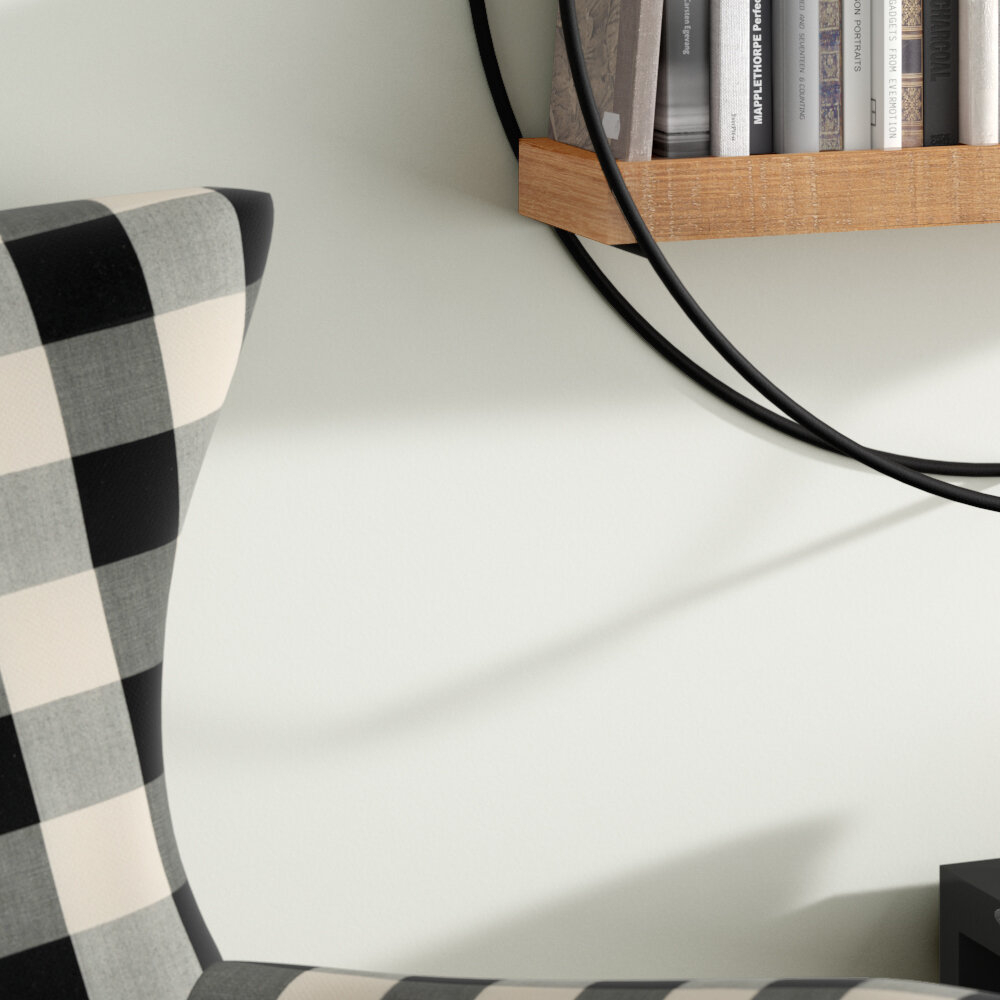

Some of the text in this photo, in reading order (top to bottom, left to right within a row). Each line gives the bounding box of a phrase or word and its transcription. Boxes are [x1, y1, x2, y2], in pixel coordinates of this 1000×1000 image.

[682, 26, 693, 55] Egevang
[889, 0, 897, 42] GADGETS
[753, 34, 763, 125] MAPPLETHORPE
[889, 48, 897, 72] FROM
[889, 78, 897, 139] EVERMOTION
